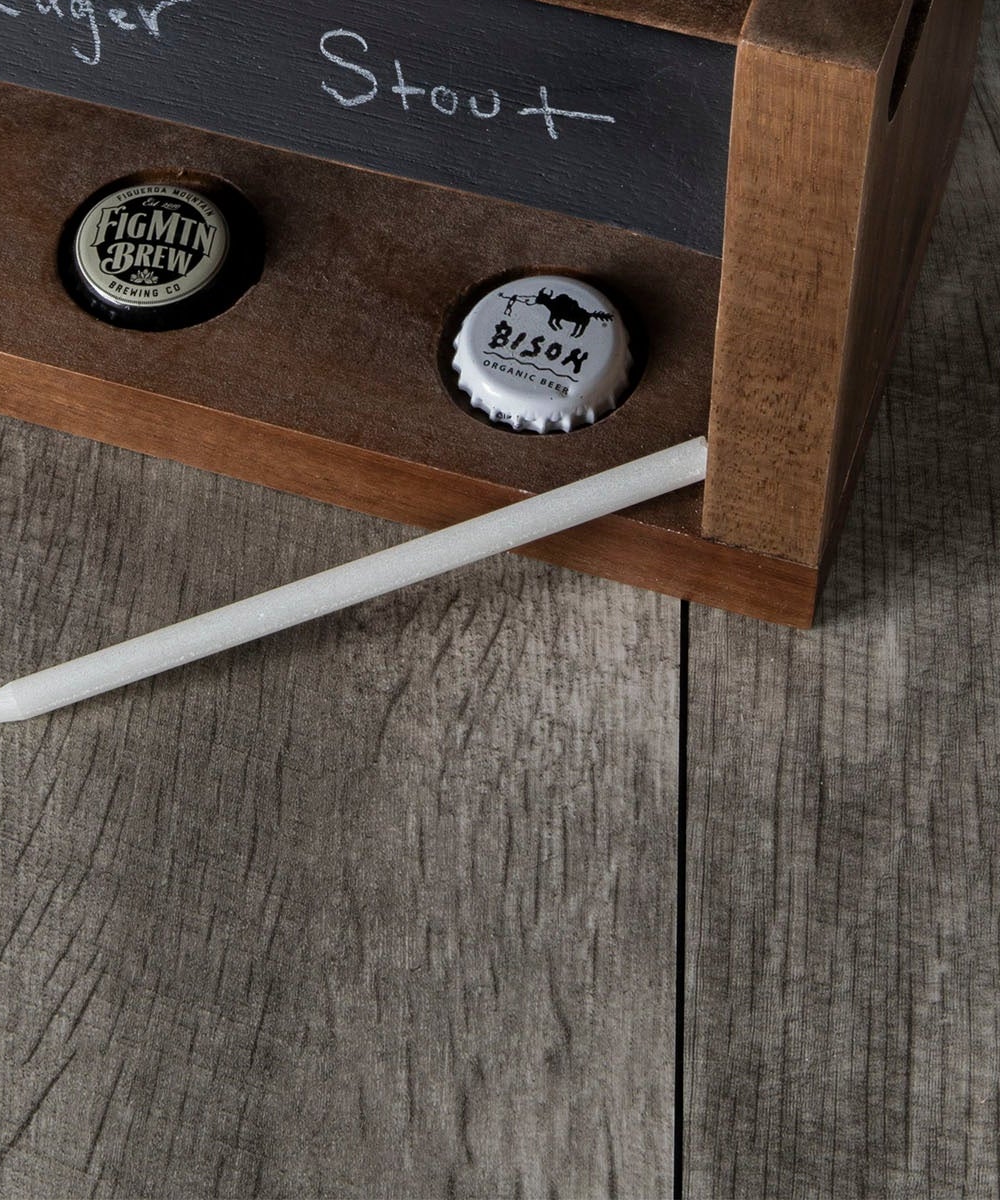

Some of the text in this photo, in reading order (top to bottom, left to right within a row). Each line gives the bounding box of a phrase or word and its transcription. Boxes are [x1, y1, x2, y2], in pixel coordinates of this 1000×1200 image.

[319, 28, 616, 140] Stout
[116, 186, 168, 202] FIGUEROA
[172, 189, 215, 217] MOUNTAIN
[99, 241, 194, 277] BREW
[109, 280, 181, 297] BREWING CO
[488, 320, 589, 374] BISON
[483, 359, 569, 396] ORGANIC BEER
